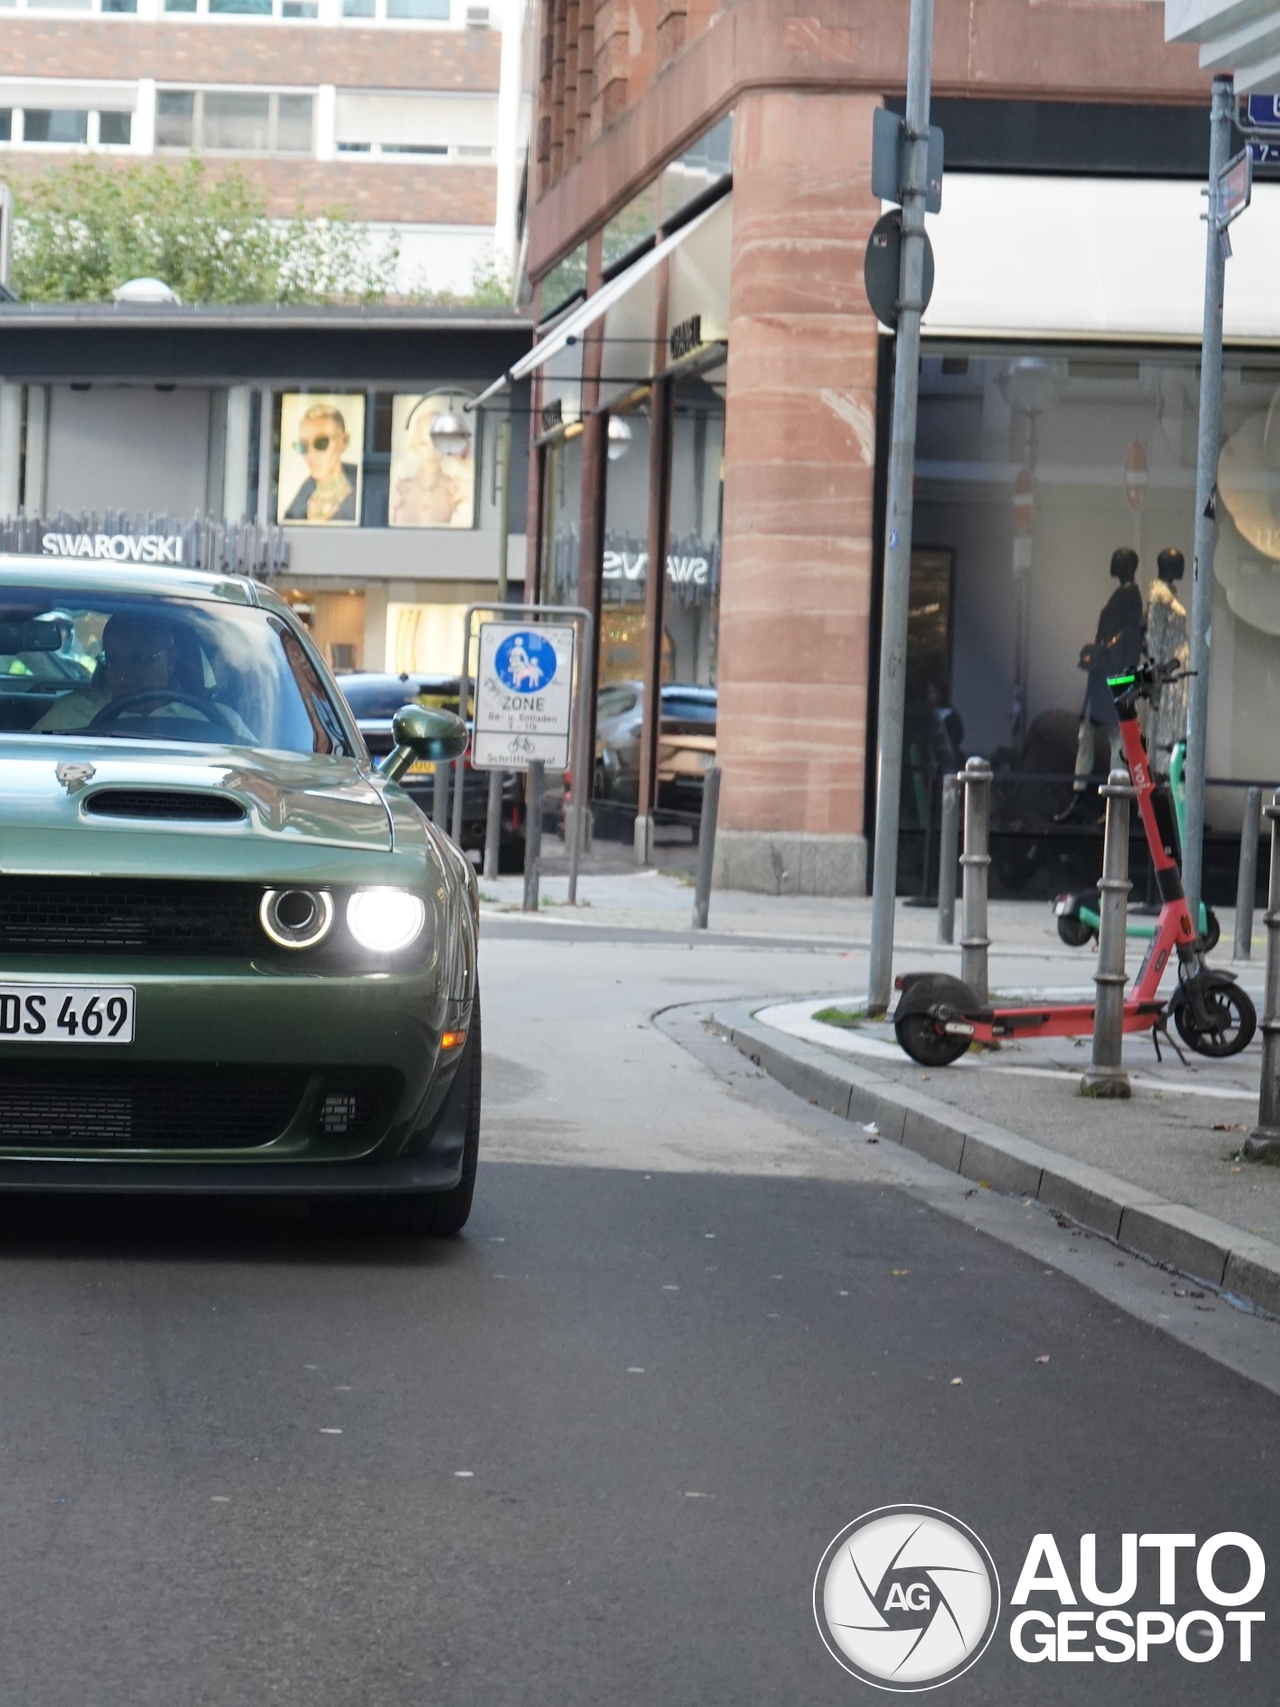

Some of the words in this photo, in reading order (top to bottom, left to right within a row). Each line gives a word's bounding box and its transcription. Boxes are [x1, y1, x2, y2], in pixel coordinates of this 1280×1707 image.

[42, 532, 184, 563] SWAROVSKI
[502, 696, 546, 712] ZONE
[519, 713, 557, 723] Entladen
[57, 996, 128, 1036] 469
